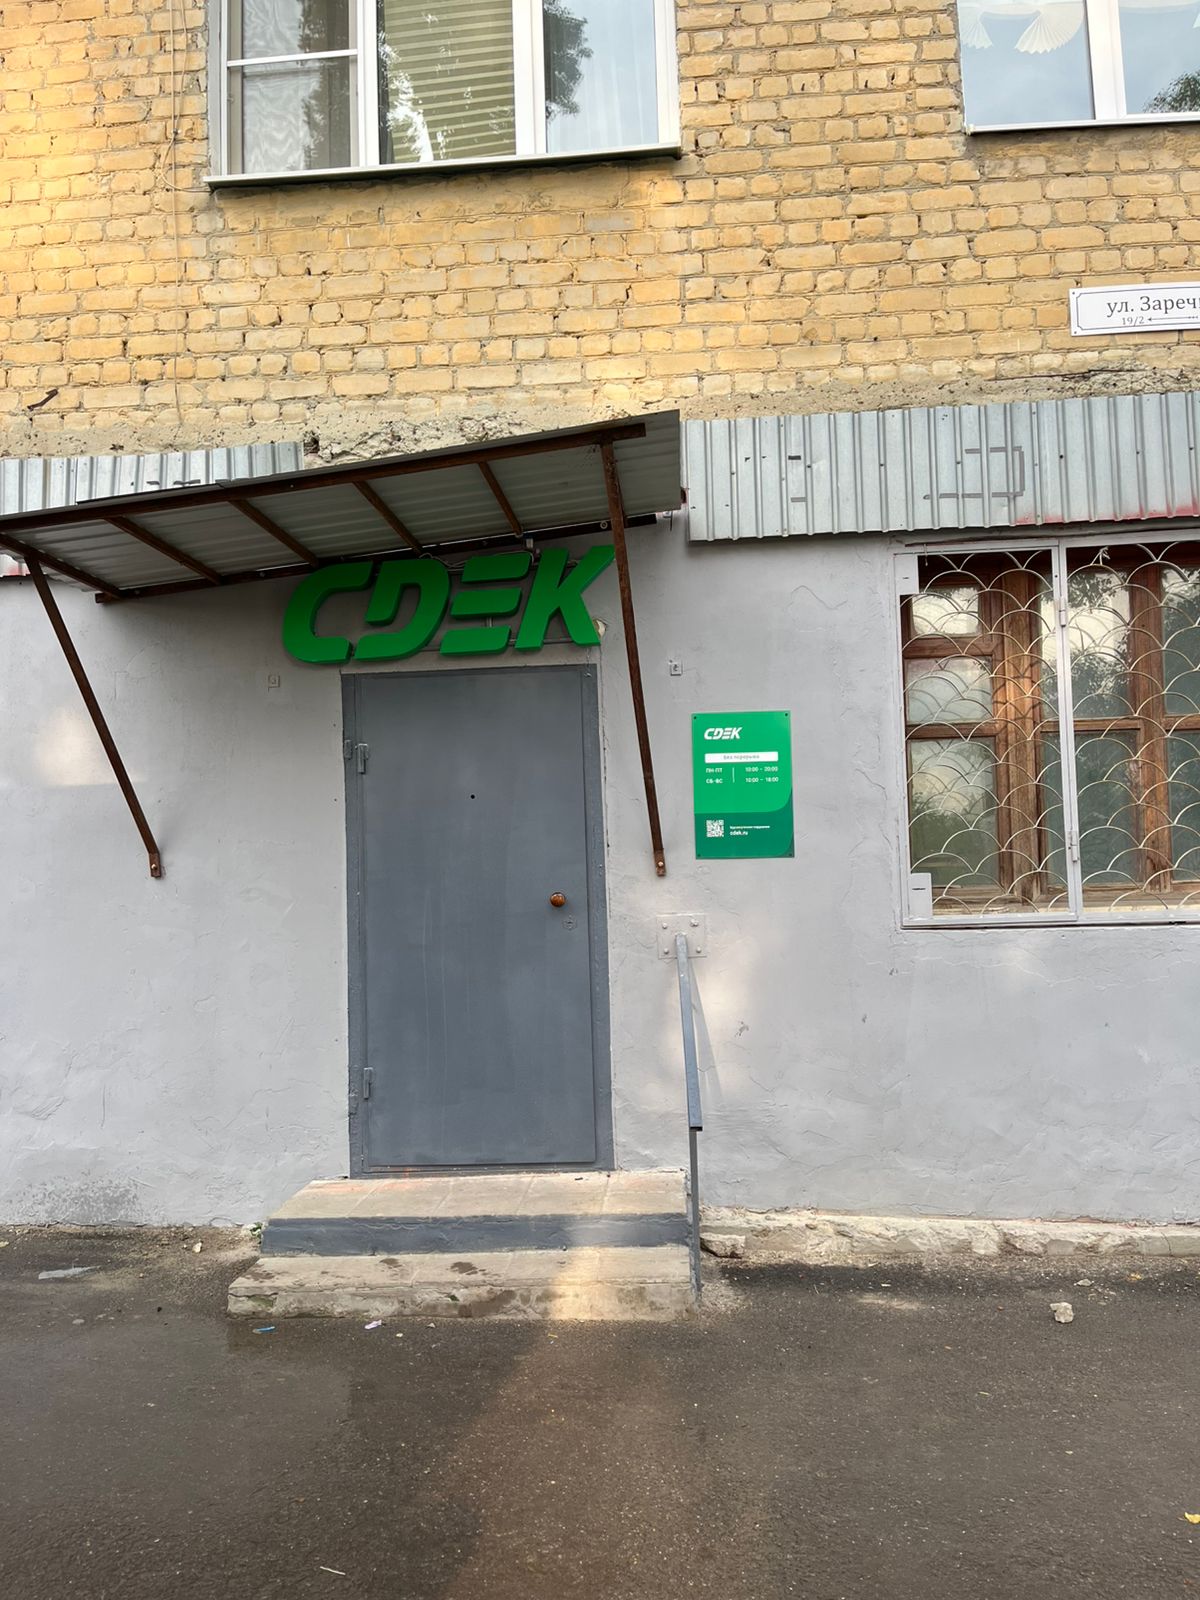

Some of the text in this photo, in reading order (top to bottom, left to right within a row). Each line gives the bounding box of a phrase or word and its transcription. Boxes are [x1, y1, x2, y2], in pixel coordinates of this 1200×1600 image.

[1106, 295, 1200, 318] ул. Зареч
[1122, 316, 1145, 327] 19/2
[281, 544, 615, 663] CDEK
[703, 727, 742, 740] CDEK
